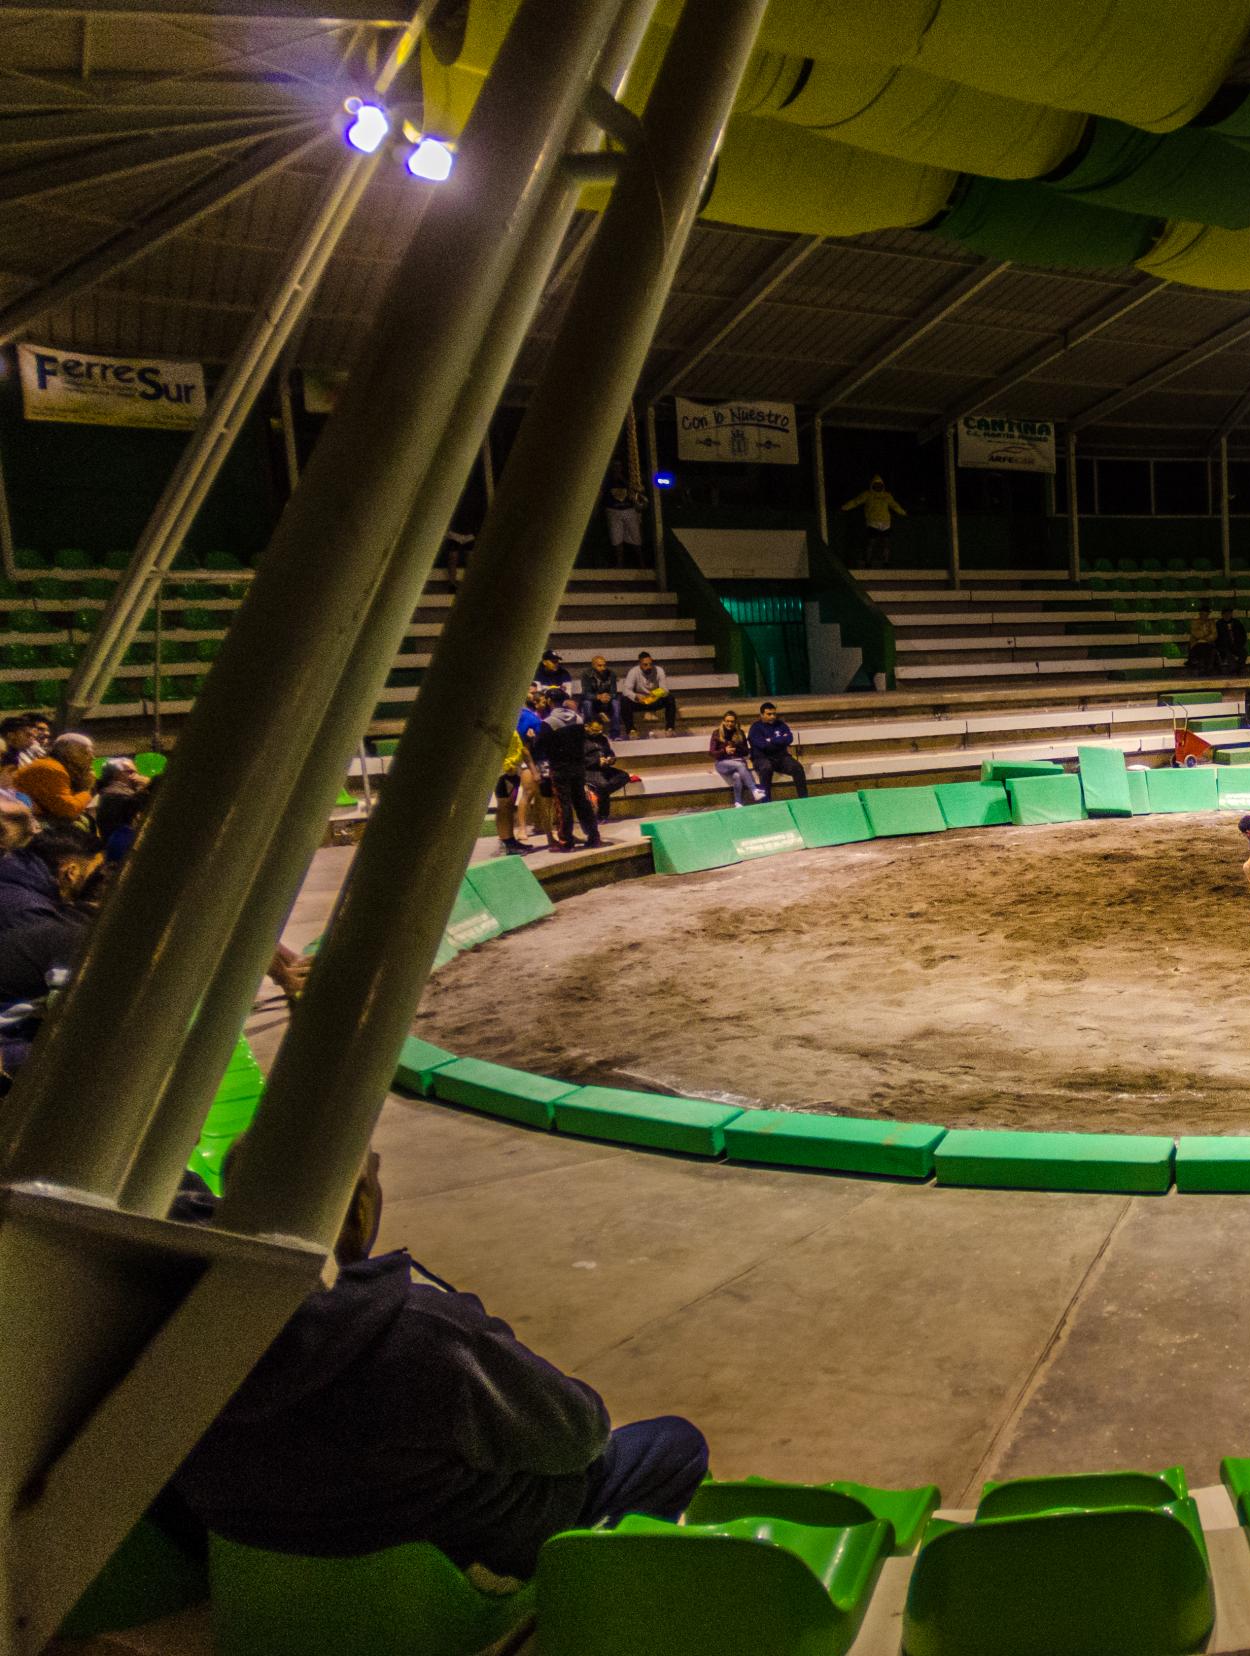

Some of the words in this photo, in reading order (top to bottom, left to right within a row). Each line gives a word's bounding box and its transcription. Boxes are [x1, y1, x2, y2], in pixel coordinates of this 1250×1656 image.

[35, 353, 196, 404] FerreSur
[681, 415, 708, 430] Con
[730, 406, 789, 427] Nuestro
[963, 416, 1052, 437] CANTINA
